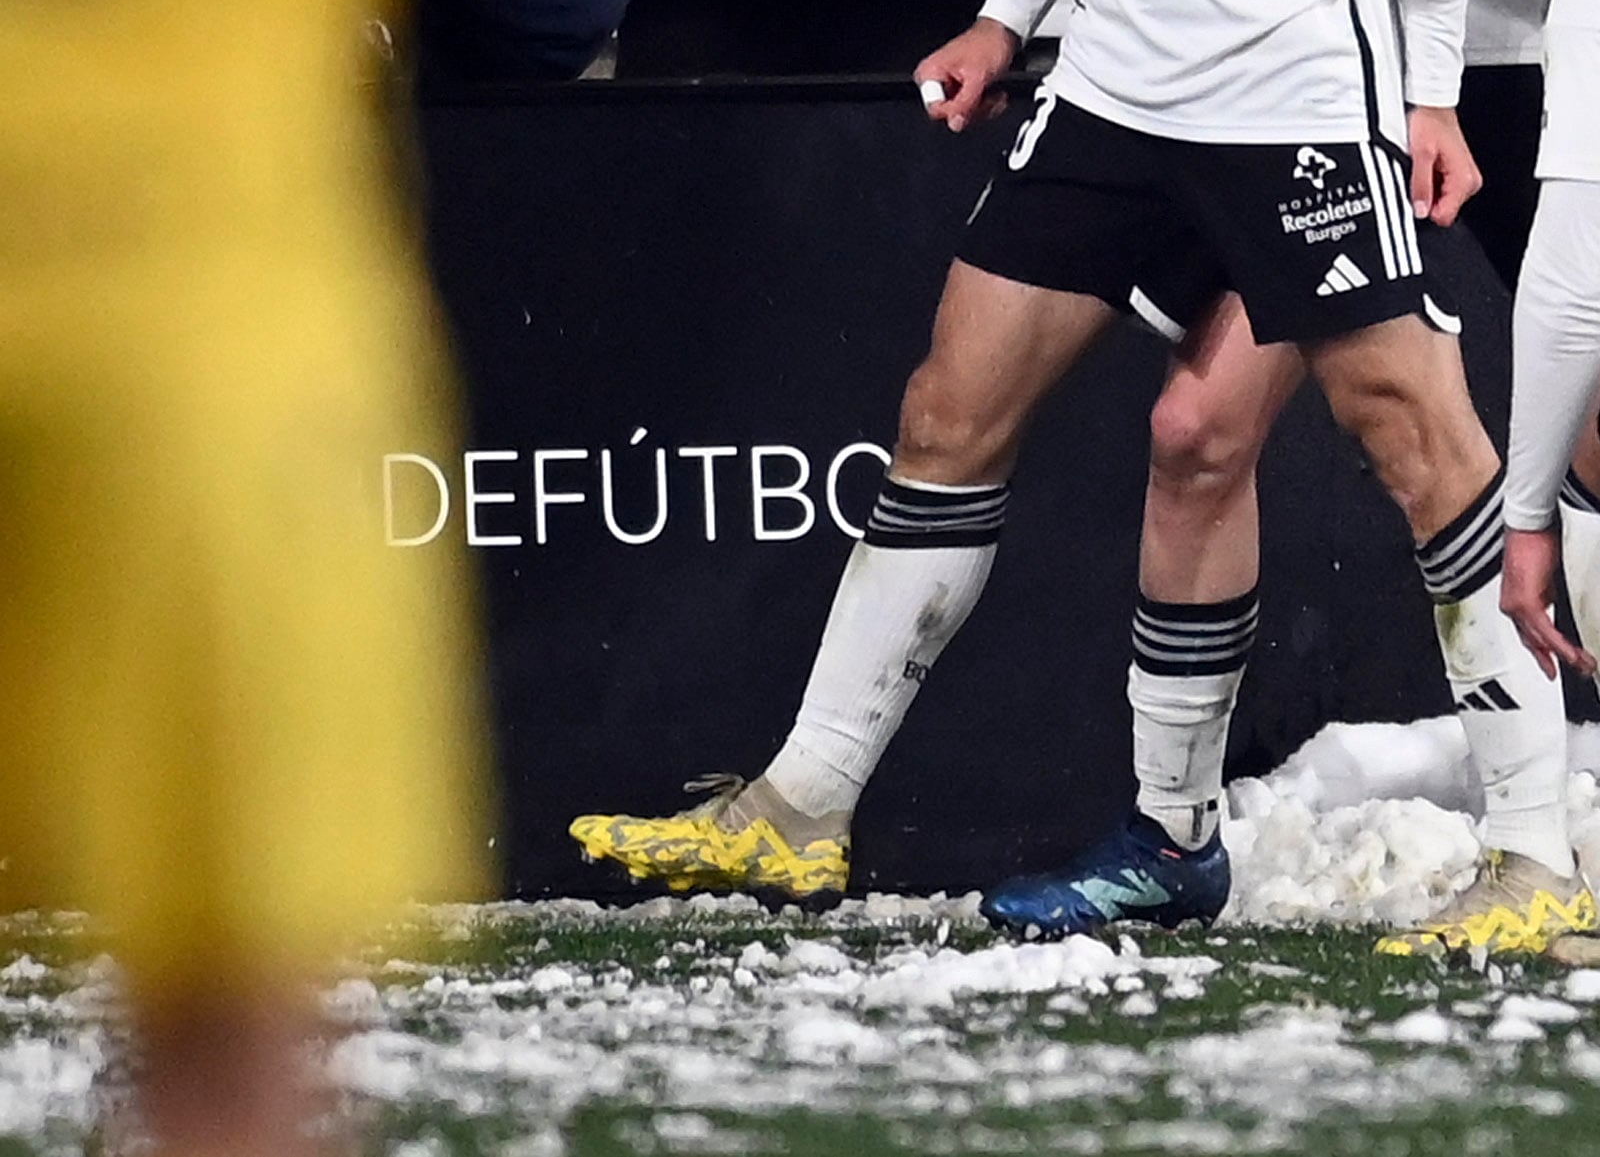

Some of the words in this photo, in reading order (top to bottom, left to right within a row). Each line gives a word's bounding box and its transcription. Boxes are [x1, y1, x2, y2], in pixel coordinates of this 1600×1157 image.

[1281, 196, 1373, 234] Recoletas
[1305, 221, 1358, 244] Burgos
[382, 427, 893, 546] DEFÚTBO
[902, 659, 930, 685] BC
